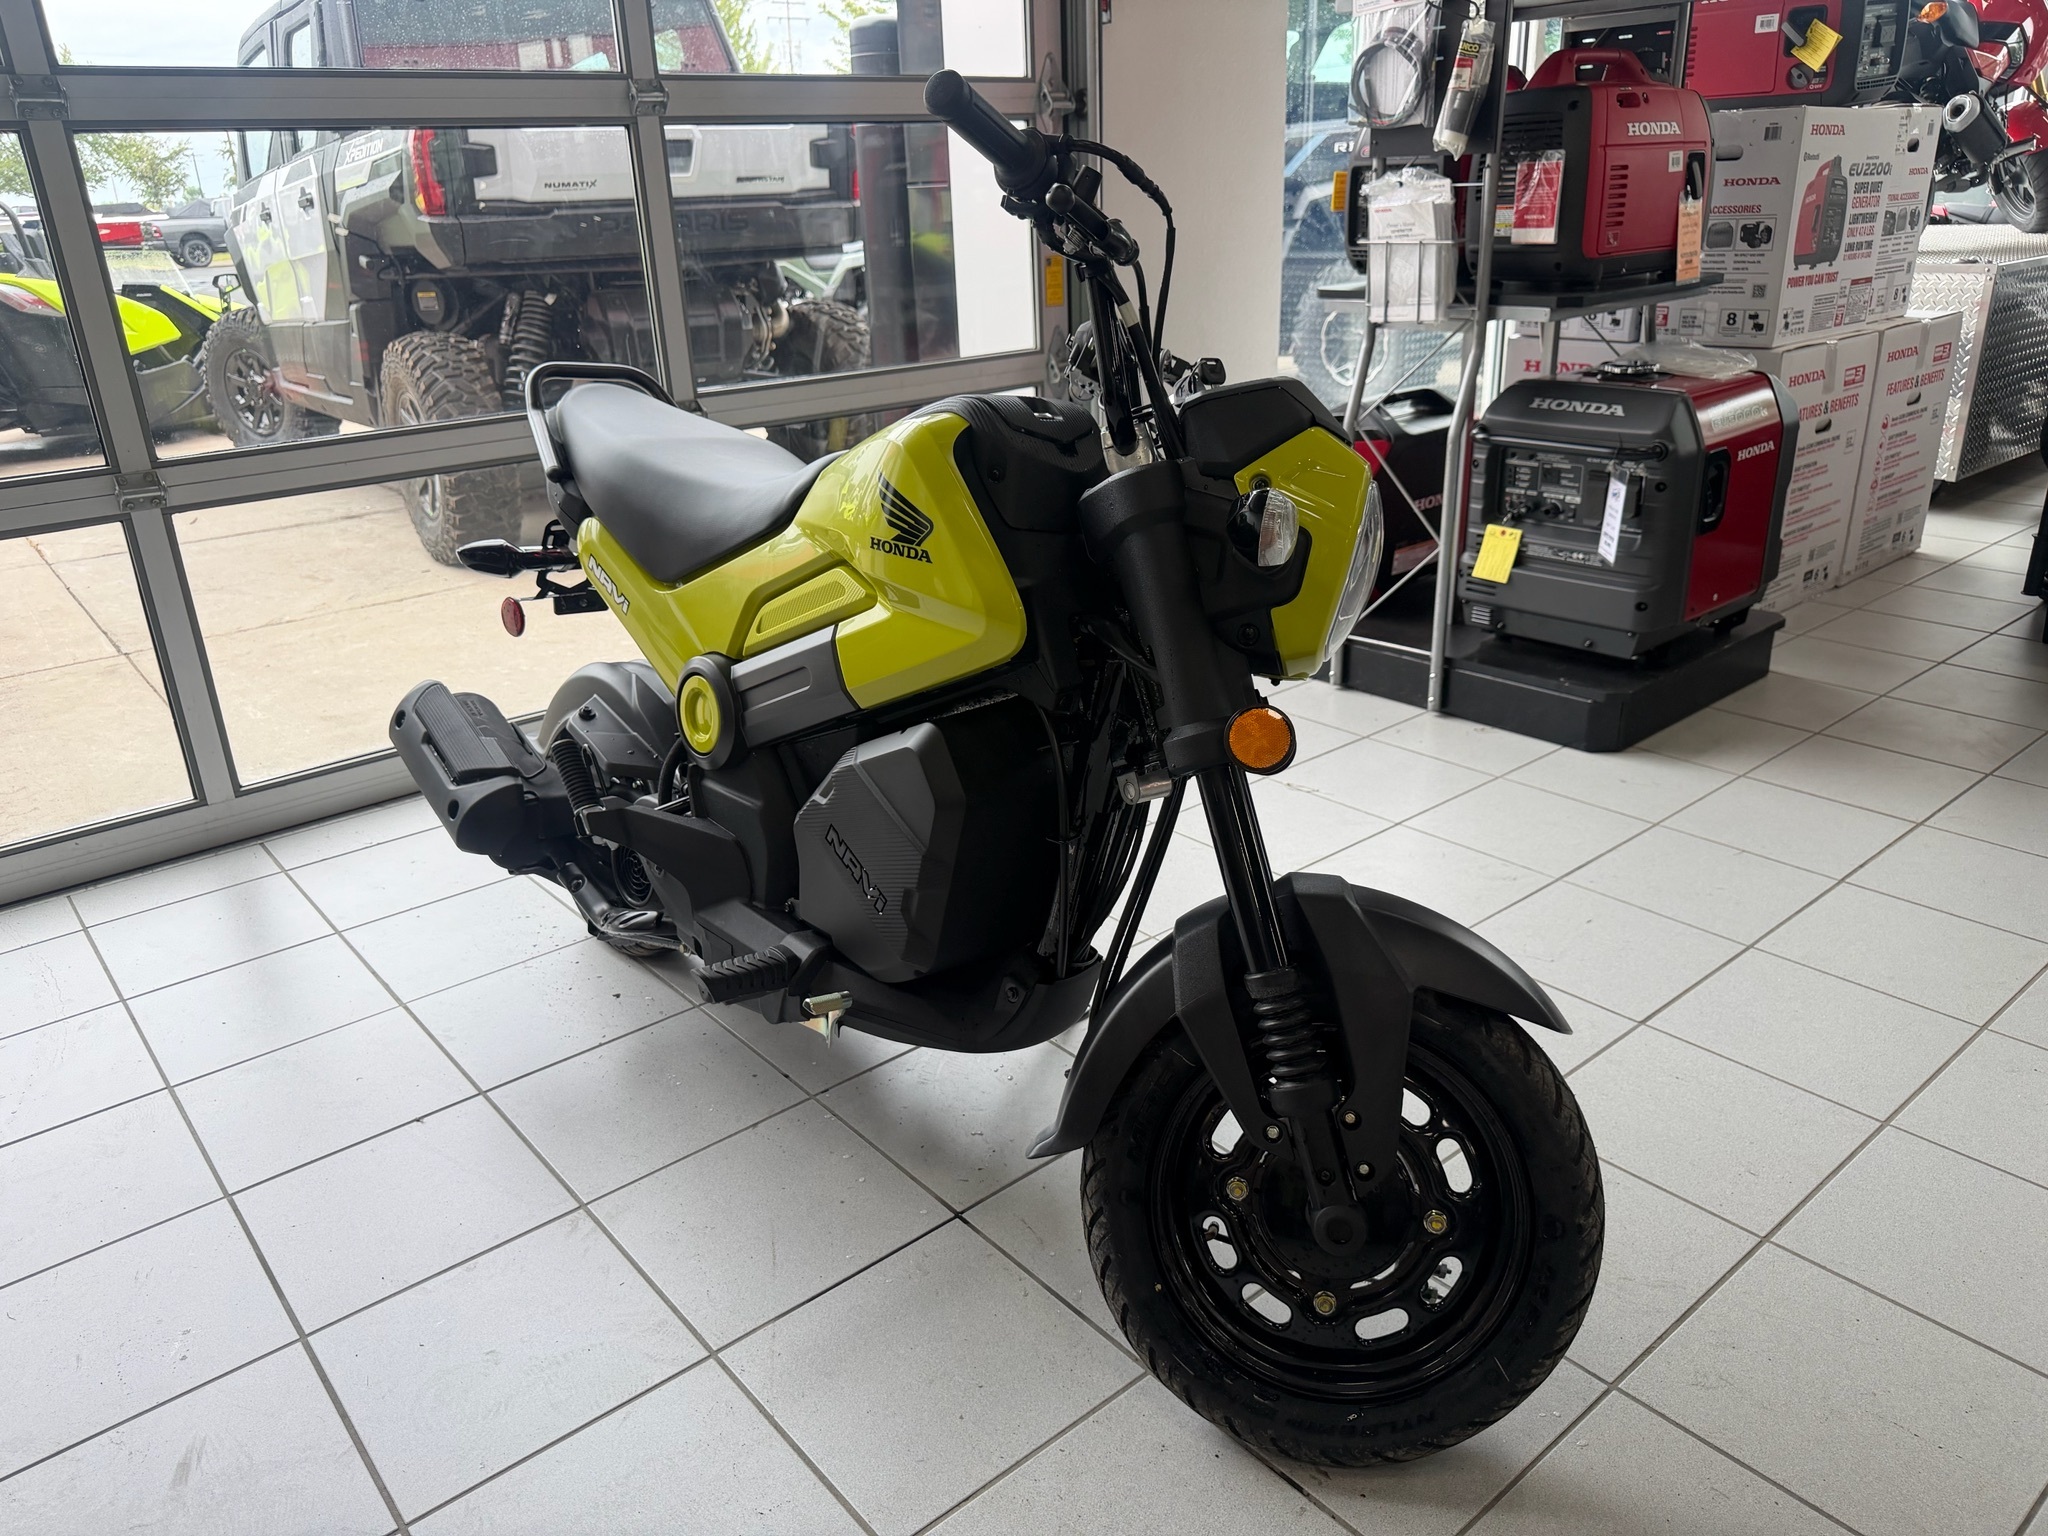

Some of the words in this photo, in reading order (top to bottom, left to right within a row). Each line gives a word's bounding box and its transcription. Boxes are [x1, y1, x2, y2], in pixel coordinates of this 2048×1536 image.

[1627, 121, 1681, 136] HONDA
[1810, 124, 1846, 136] HONDA
[1848, 162, 1893, 177] EU2200i
[1909, 167, 1929, 176] HONDA
[544, 179, 598, 189] NUMATIX
[1723, 176, 1781, 188] HONDA
[1853, 181, 1870, 195] SUPER
[1851, 195, 1881, 209] GENERATOR
[1787, 275, 1805, 289] POWER
[1804, 274, 1815, 287] YOU
[1813, 273, 1825, 285] CAN
[1824, 271, 1840, 284] TRUST
[1726, 312, 1737, 326] 8
[1887, 346, 1919, 362] HONDA
[1788, 370, 1826, 388] HONDA
[1886, 377, 1915, 396] FEATURES
[1914, 375, 1920, 389] &
[1920, 368, 1946, 387] BENEFITS
[1529, 398, 1626, 417] HONDA
[1823, 400, 1830, 415] &
[1830, 393, 1860, 413] BENEFITS
[1737, 440, 1775, 461] HONDA
[870, 536, 933, 564] HONDA
